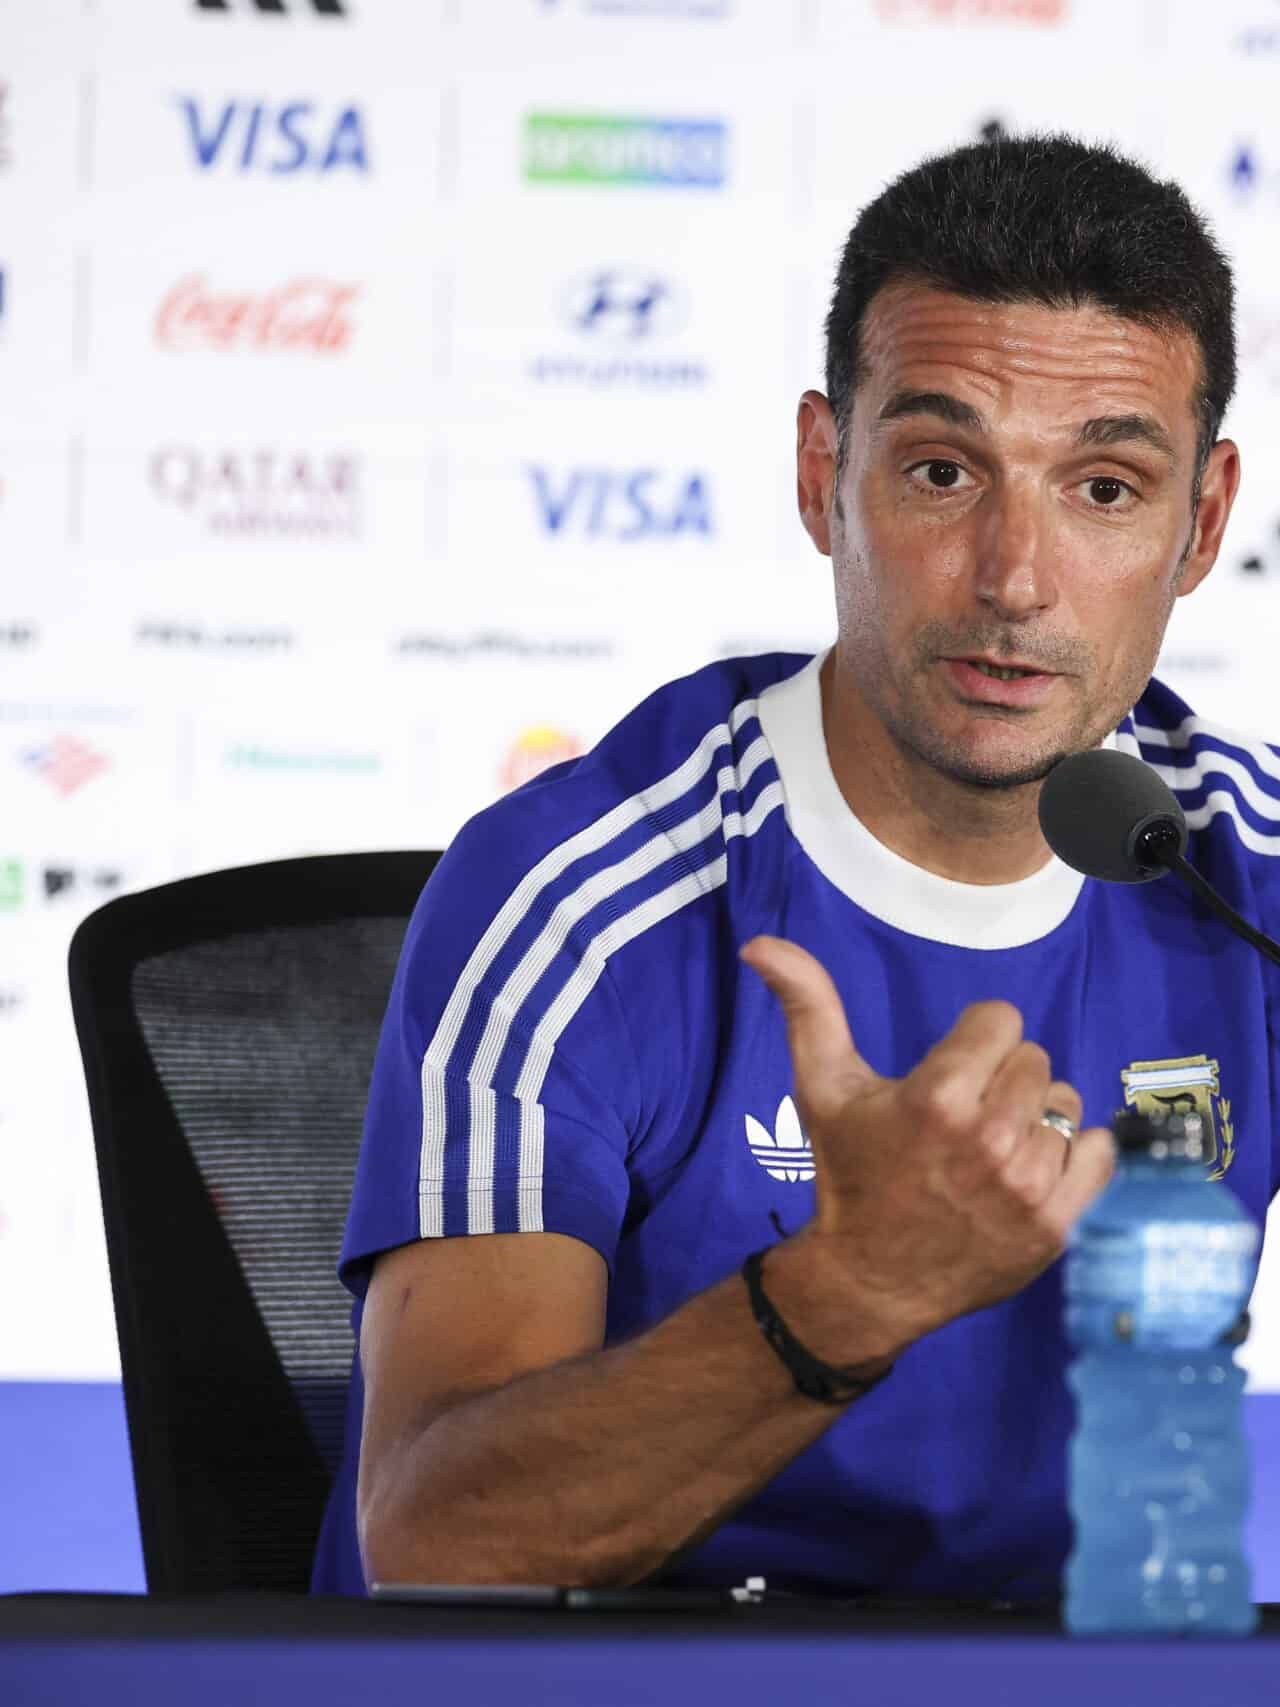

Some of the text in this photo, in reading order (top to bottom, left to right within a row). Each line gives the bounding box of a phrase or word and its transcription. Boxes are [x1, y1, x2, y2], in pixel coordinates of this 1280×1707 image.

[179, 96, 370, 176] VISA
[148, 448, 360, 506] QATAR
[527, 465, 715, 541] VISA
